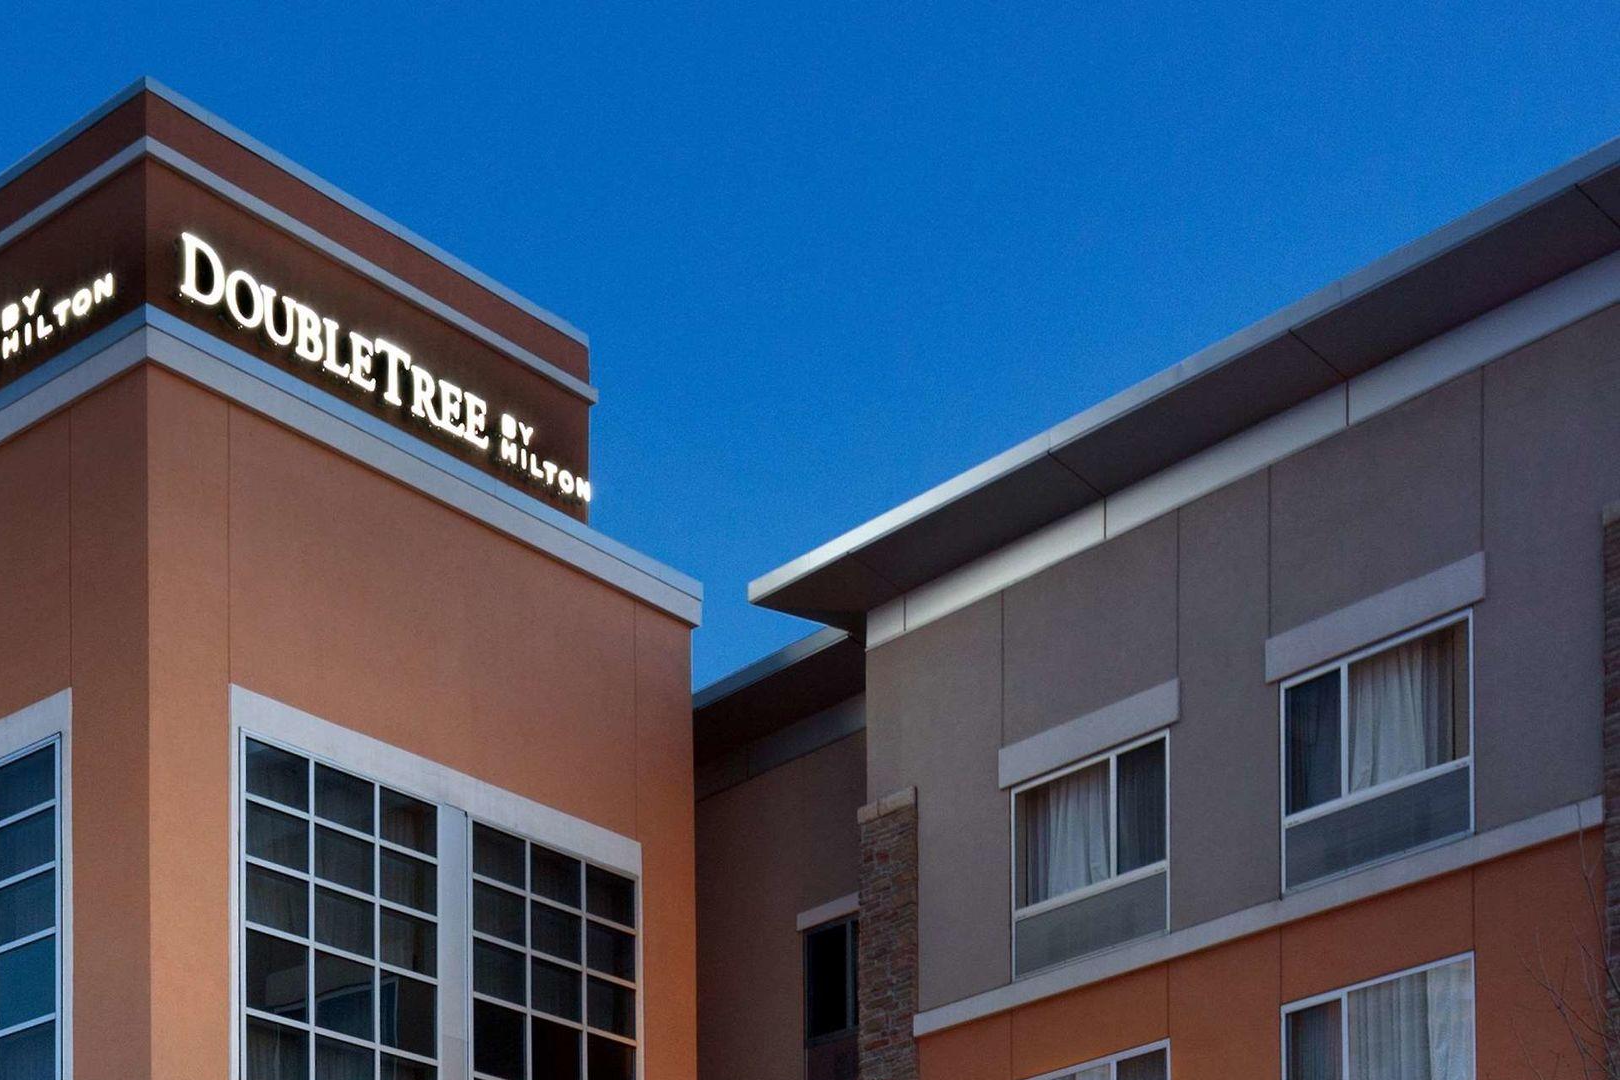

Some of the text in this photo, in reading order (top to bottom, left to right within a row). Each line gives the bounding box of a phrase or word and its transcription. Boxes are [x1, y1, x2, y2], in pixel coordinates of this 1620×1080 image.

[1, 288, 41, 332] BY
[1, 272, 114, 360] HILTON
[501, 413, 534, 446] BY
[501, 437, 592, 503] HILTON
